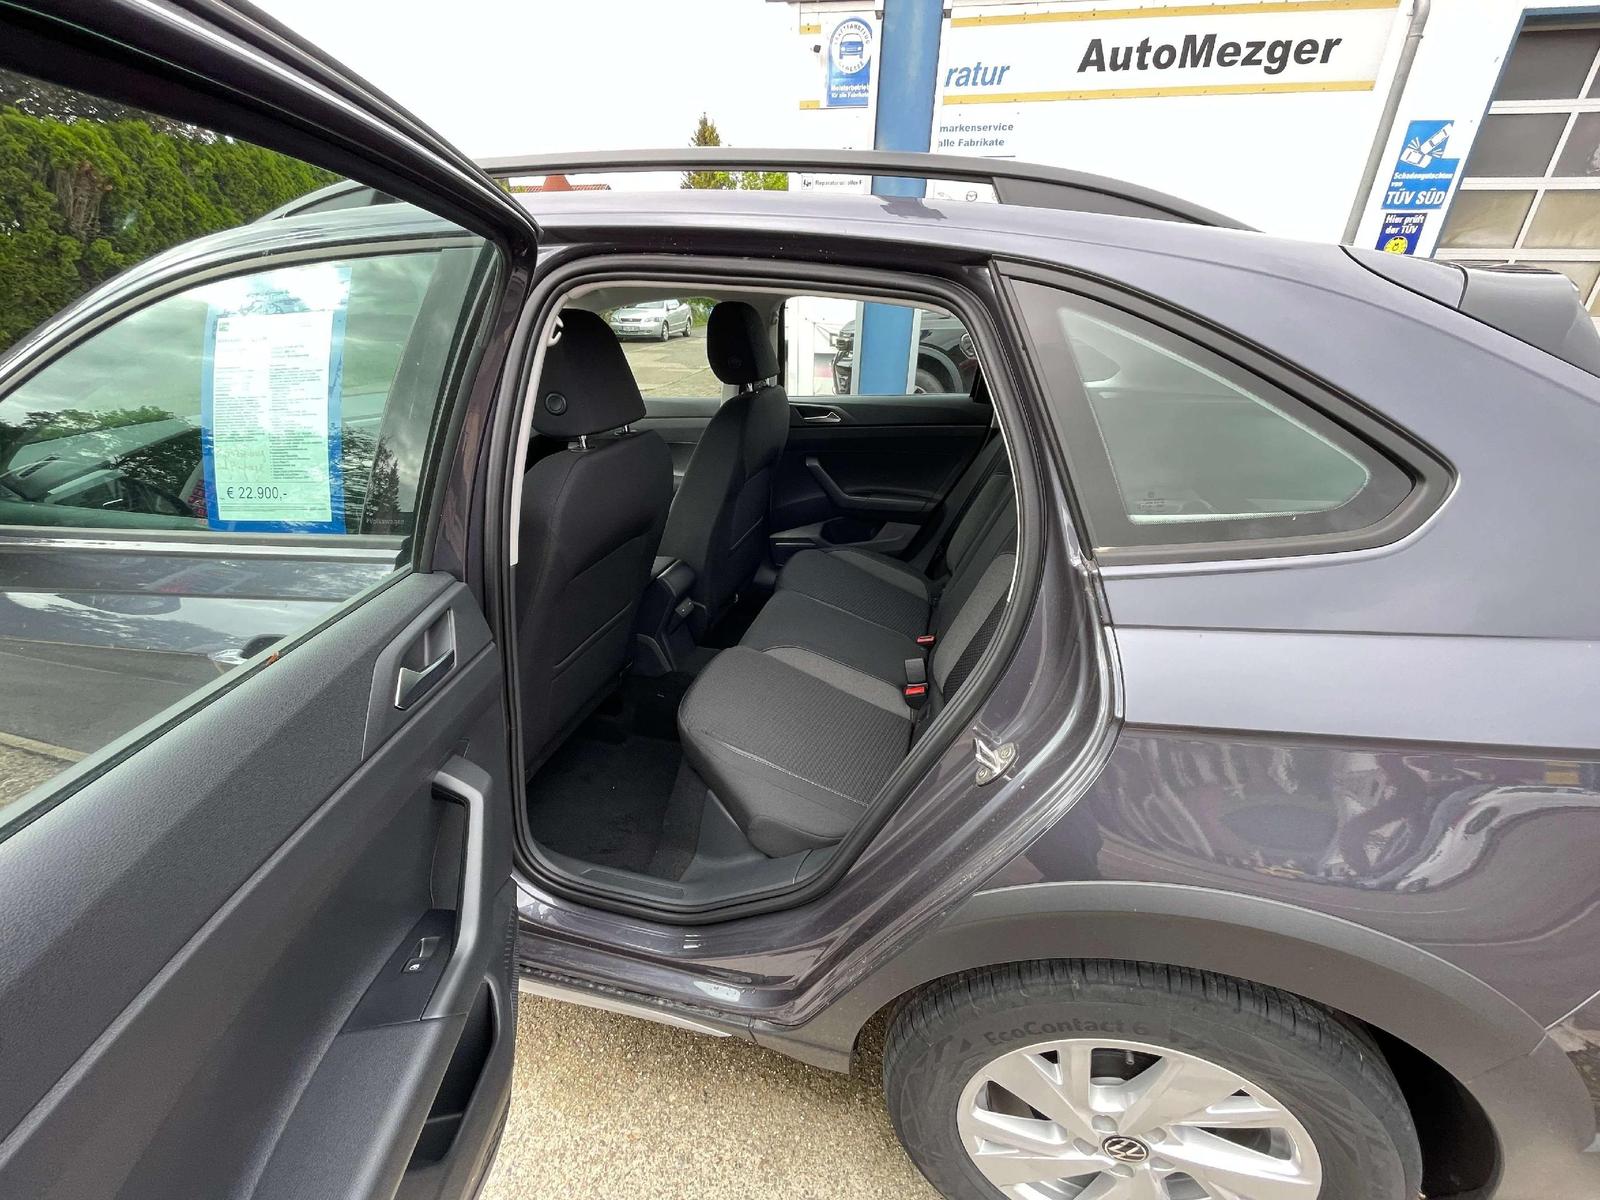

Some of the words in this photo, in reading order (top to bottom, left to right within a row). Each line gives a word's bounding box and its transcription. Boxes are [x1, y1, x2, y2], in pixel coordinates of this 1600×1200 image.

[1077, 33, 1342, 74] AutoMezger
[944, 61, 1010, 87] ratur
[939, 122, 1014, 132] markenservice
[958, 137, 1005, 147] Fabrikate
[1386, 188, 1416, 204] TÜV
[1415, 188, 1445, 204] SÜD
[1385, 214, 1404, 224] Hier
[1403, 214, 1424, 225] prüft
[1386, 226, 1400, 234] der
[1401, 223, 1418, 234] TÜV
[226, 486, 234, 499] €
[984, 1018, 1124, 1045] EcoContact
